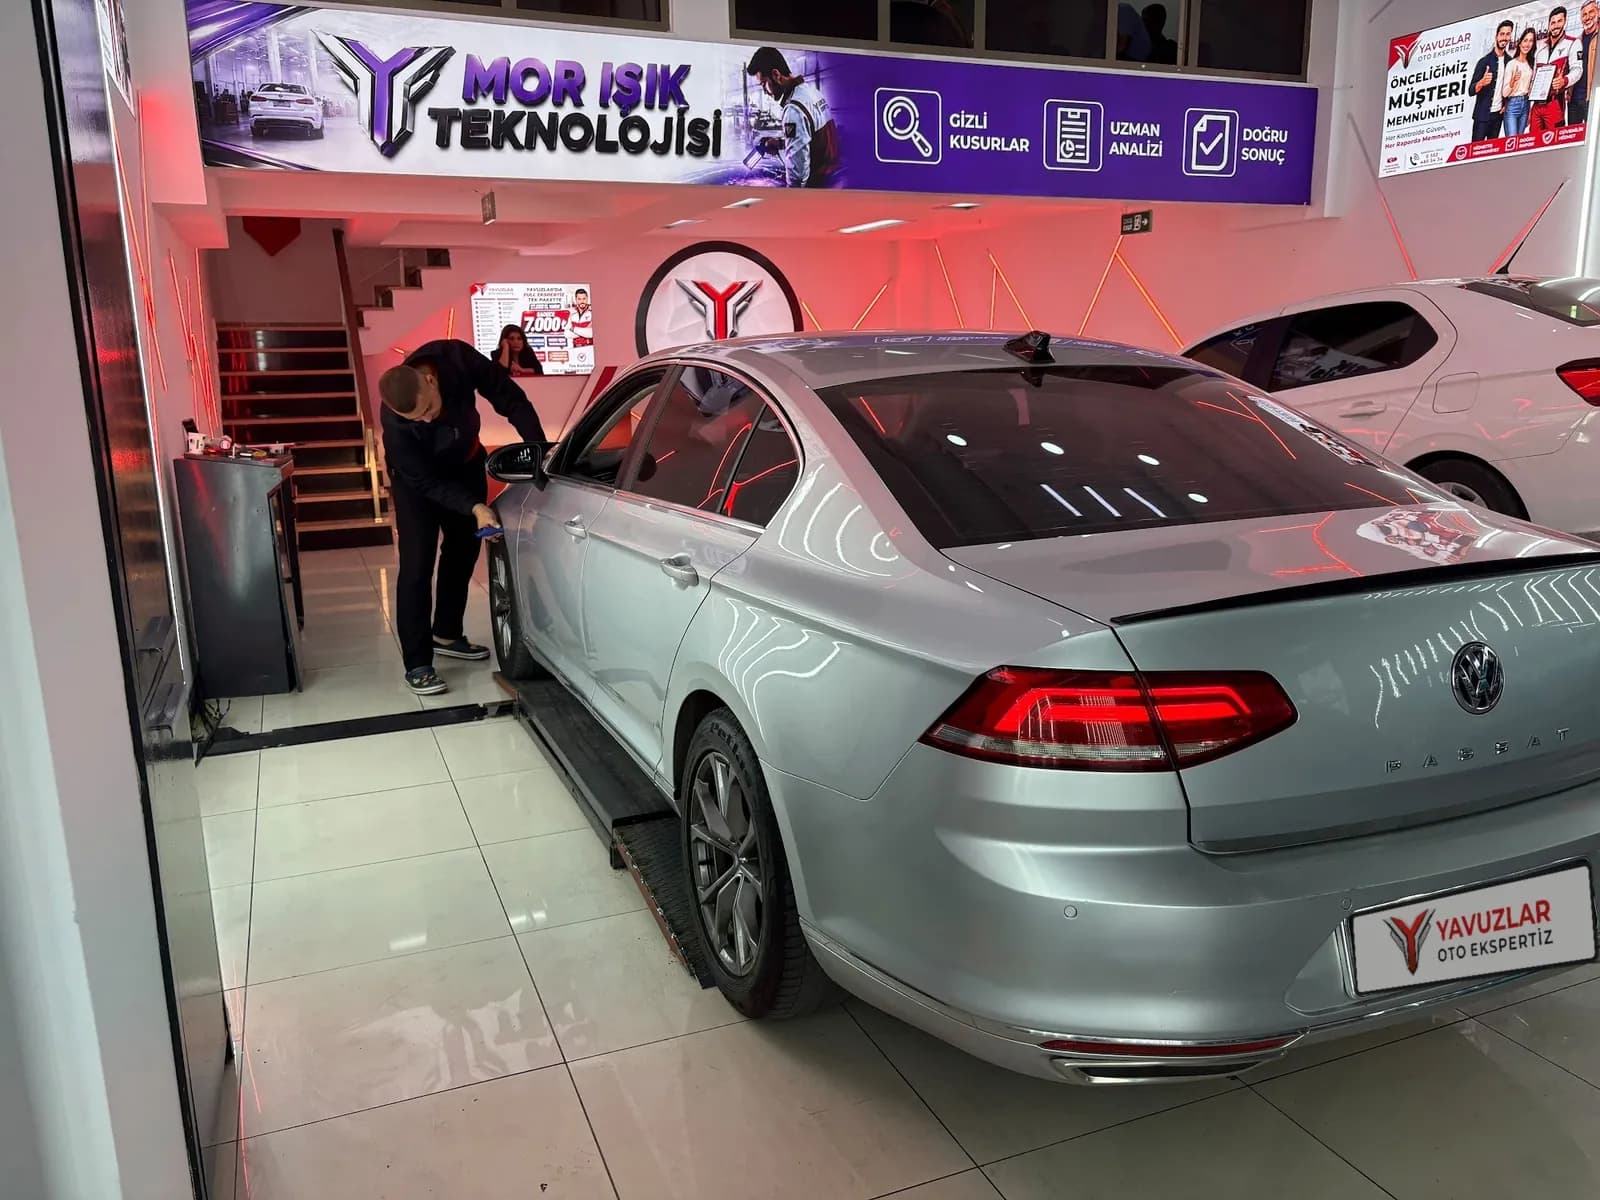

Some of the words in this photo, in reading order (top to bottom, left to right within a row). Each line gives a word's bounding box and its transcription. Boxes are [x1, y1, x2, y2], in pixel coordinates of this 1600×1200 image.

[1417, 53, 1432, 62] OTO
[1433, 44, 1471, 58] EKSPERTİZ
[1419, 32, 1472, 53] YAVUZLAR
[462, 53, 586, 107] MOR
[599, 61, 692, 117] IŞIK
[1390, 60, 1468, 89] ÖNCELİĞİMİZ
[1388, 73, 1467, 111] MÜŞTERİ
[949, 109, 988, 130] GİZLİ
[1386, 99, 1465, 128] MEMNUNİYETİ
[427, 106, 723, 158] TEKNOLOJİSİ
[1110, 121, 1160, 138] UZMAN
[1243, 126, 1288, 143] DOĞRU
[1396, 138, 1421, 147] Raporda
[1422, 130, 1461, 142] Memnuniyet
[949, 134, 1030, 153] KUSURLAR
[1109, 140, 1163, 158] ANALİZİ
[1241, 147, 1286, 165] SONUÇ
[1385, 727, 1570, 774] PASSAT
[1436, 899, 1552, 942] YAVUZLAR
[1437, 944, 1467, 962] OTO
[1471, 929, 1554, 958] EKSPERTİZ
